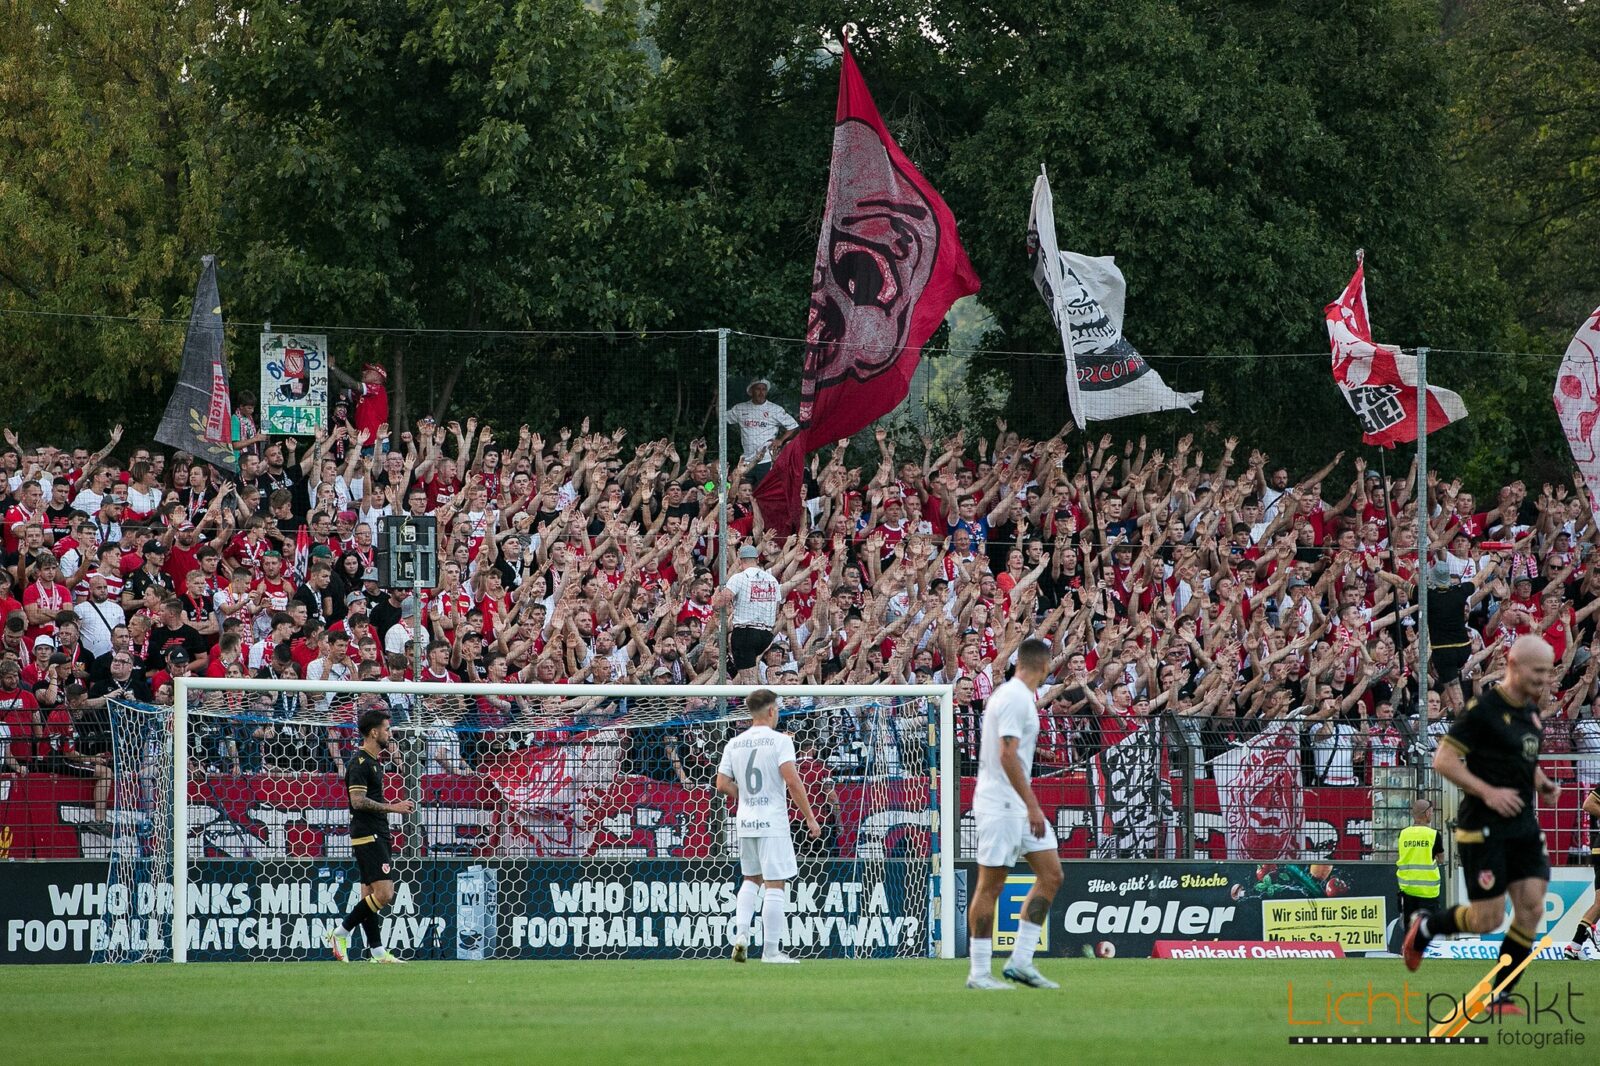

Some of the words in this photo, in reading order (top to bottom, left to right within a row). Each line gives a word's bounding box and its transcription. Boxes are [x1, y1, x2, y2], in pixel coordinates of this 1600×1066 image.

[733, 738, 775, 749] BABELSBERG
[745, 748, 763, 795] 6
[740, 819, 771, 830] Katjes
[1403, 840, 1430, 849] ORDNER
[1088, 879, 1117, 893] Hier
[1119, 874, 1156, 896] gibt's
[1158, 876, 1178, 889] die
[1181, 873, 1228, 889] Frische
[48, 883, 128, 916] WHO
[138, 883, 252, 915] DRNKS
[261, 883, 340, 914] MILK
[393, 882, 415, 914] A
[550, 882, 624, 913] WHO
[633, 882, 737, 913] DRINKS
[824, 882, 863, 913] AT
[868, 882, 889, 913] A
[1064, 900, 1236, 935] Gabler
[1272, 908, 1291, 922] Wir
[1295, 907, 1318, 921] sind
[1321, 907, 1338, 920] für
[1341, 906, 1357, 920] Sie
[1361, 905, 1378, 919] da!
[8, 919, 165, 951] FOOTBALL
[512, 916, 655, 948] FOOTBALL
[1364, 931, 1384, 944] Uhr
[1171, 946, 1247, 959] nahkauf
[1251, 946, 1336, 959] Oelmann
